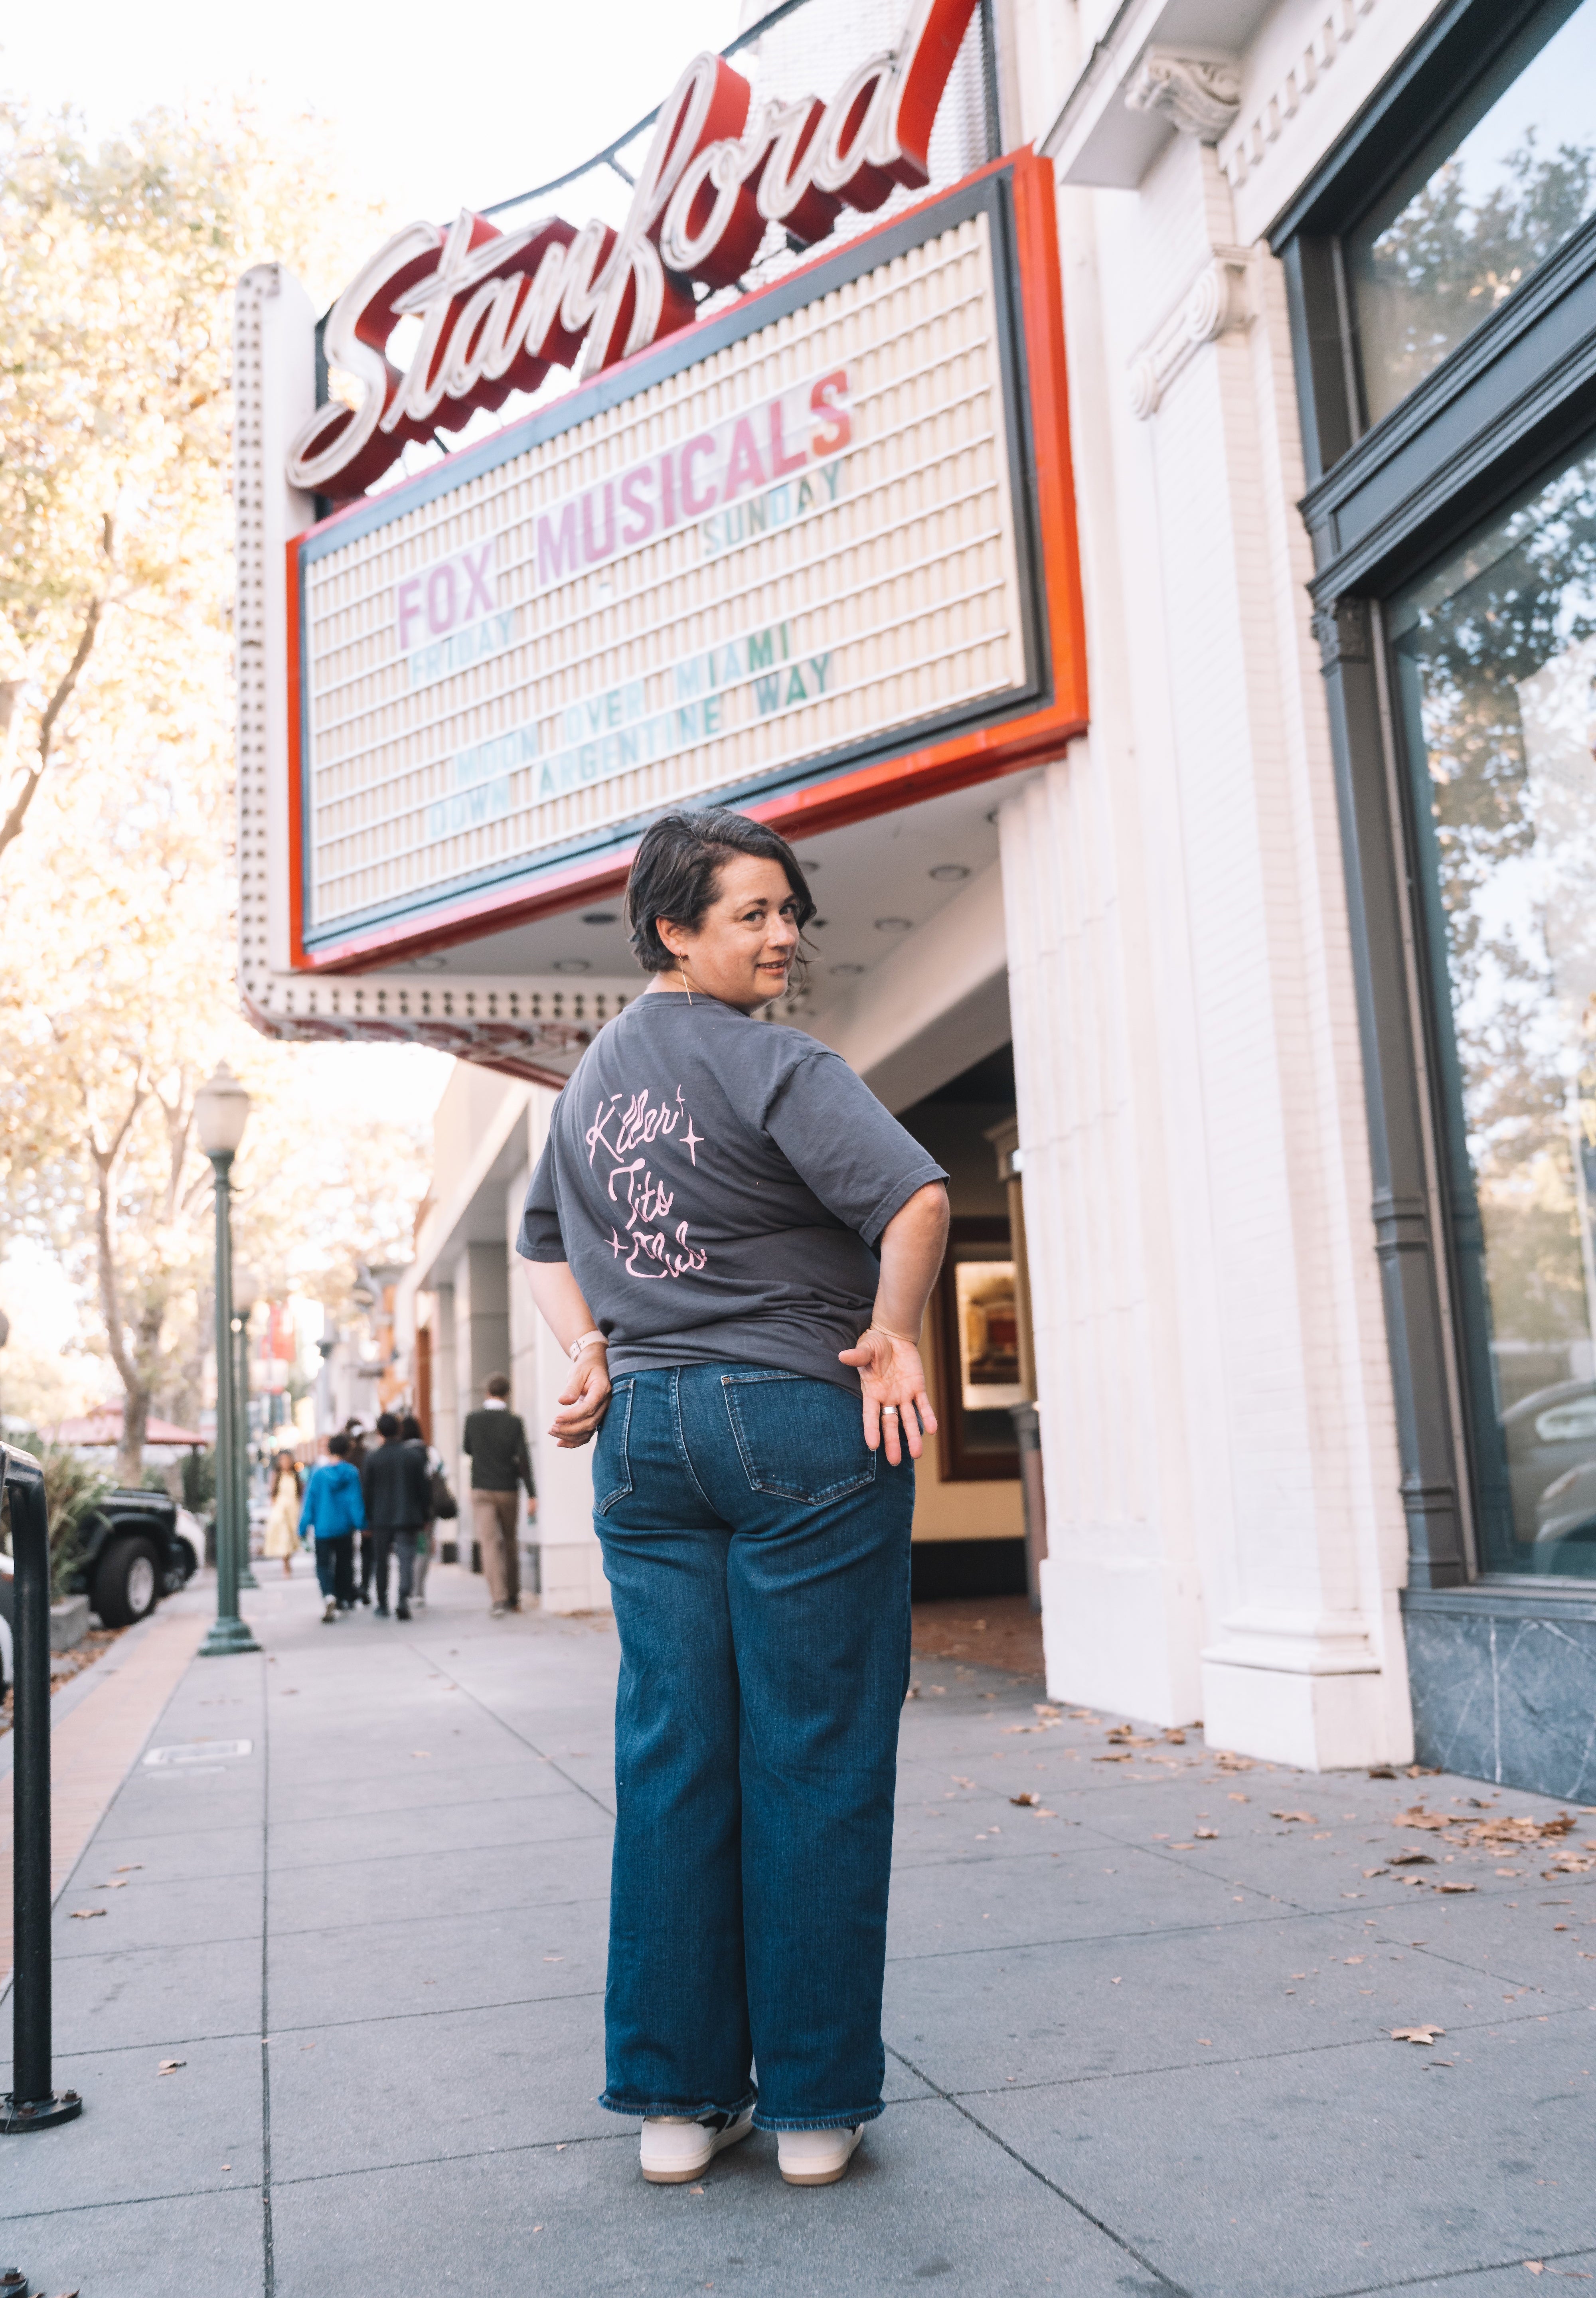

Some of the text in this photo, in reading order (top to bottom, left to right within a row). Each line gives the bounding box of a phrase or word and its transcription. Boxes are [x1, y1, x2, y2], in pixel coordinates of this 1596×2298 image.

[285, 0, 937, 490] Stanford
[398, 370, 852, 650] FOX MUSICALS
[411, 460, 843, 685] FRIDAY SUNDAY
[431, 652, 832, 837] DOWN ARGENTINE WAY
[456, 623, 789, 784] MOON OVER MIAMI
